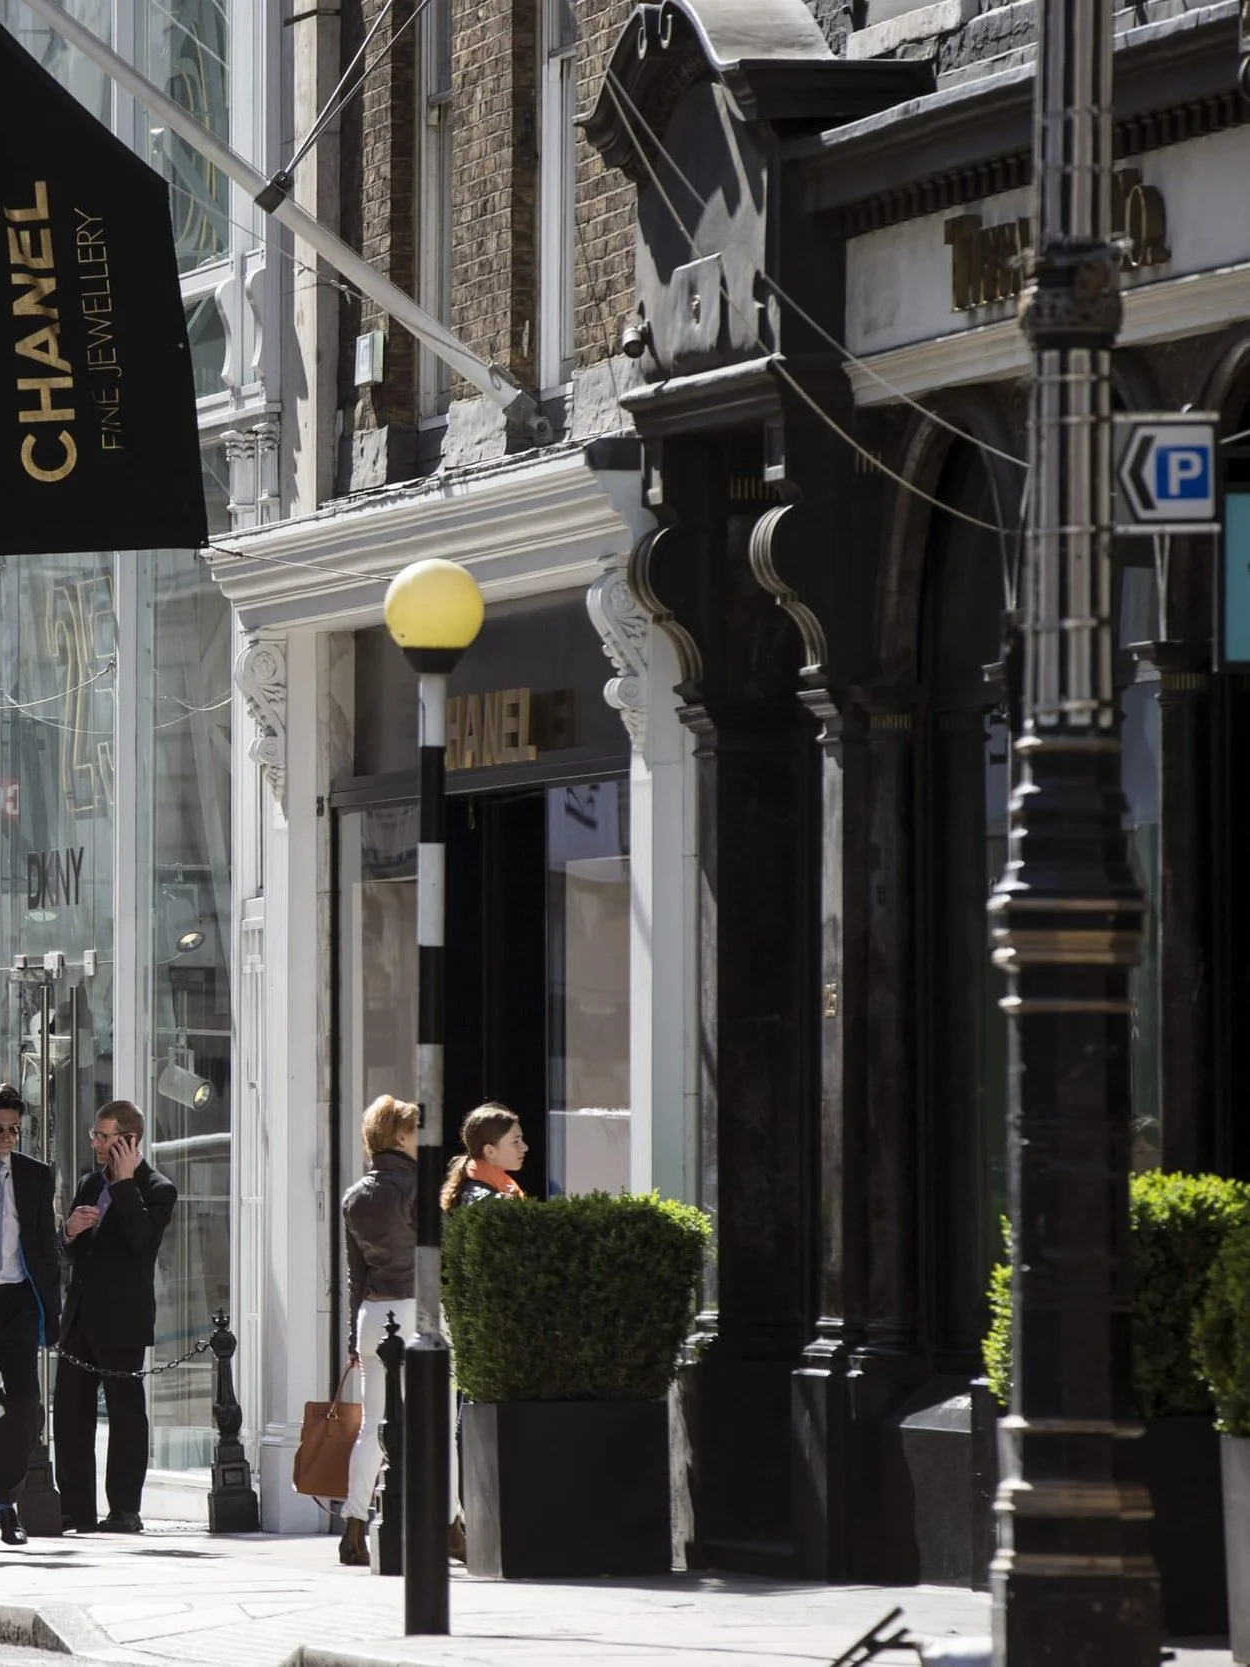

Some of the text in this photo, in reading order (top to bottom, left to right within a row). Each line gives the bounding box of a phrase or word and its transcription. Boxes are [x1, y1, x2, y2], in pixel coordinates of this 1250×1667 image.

[2, 180, 78, 482] CHANEL
[74, 207, 126, 450] FINE JEWELLERY
[1167, 451, 1203, 497] P
[444, 688, 538, 772] HANEL
[27, 846, 85, 910] DKNY
